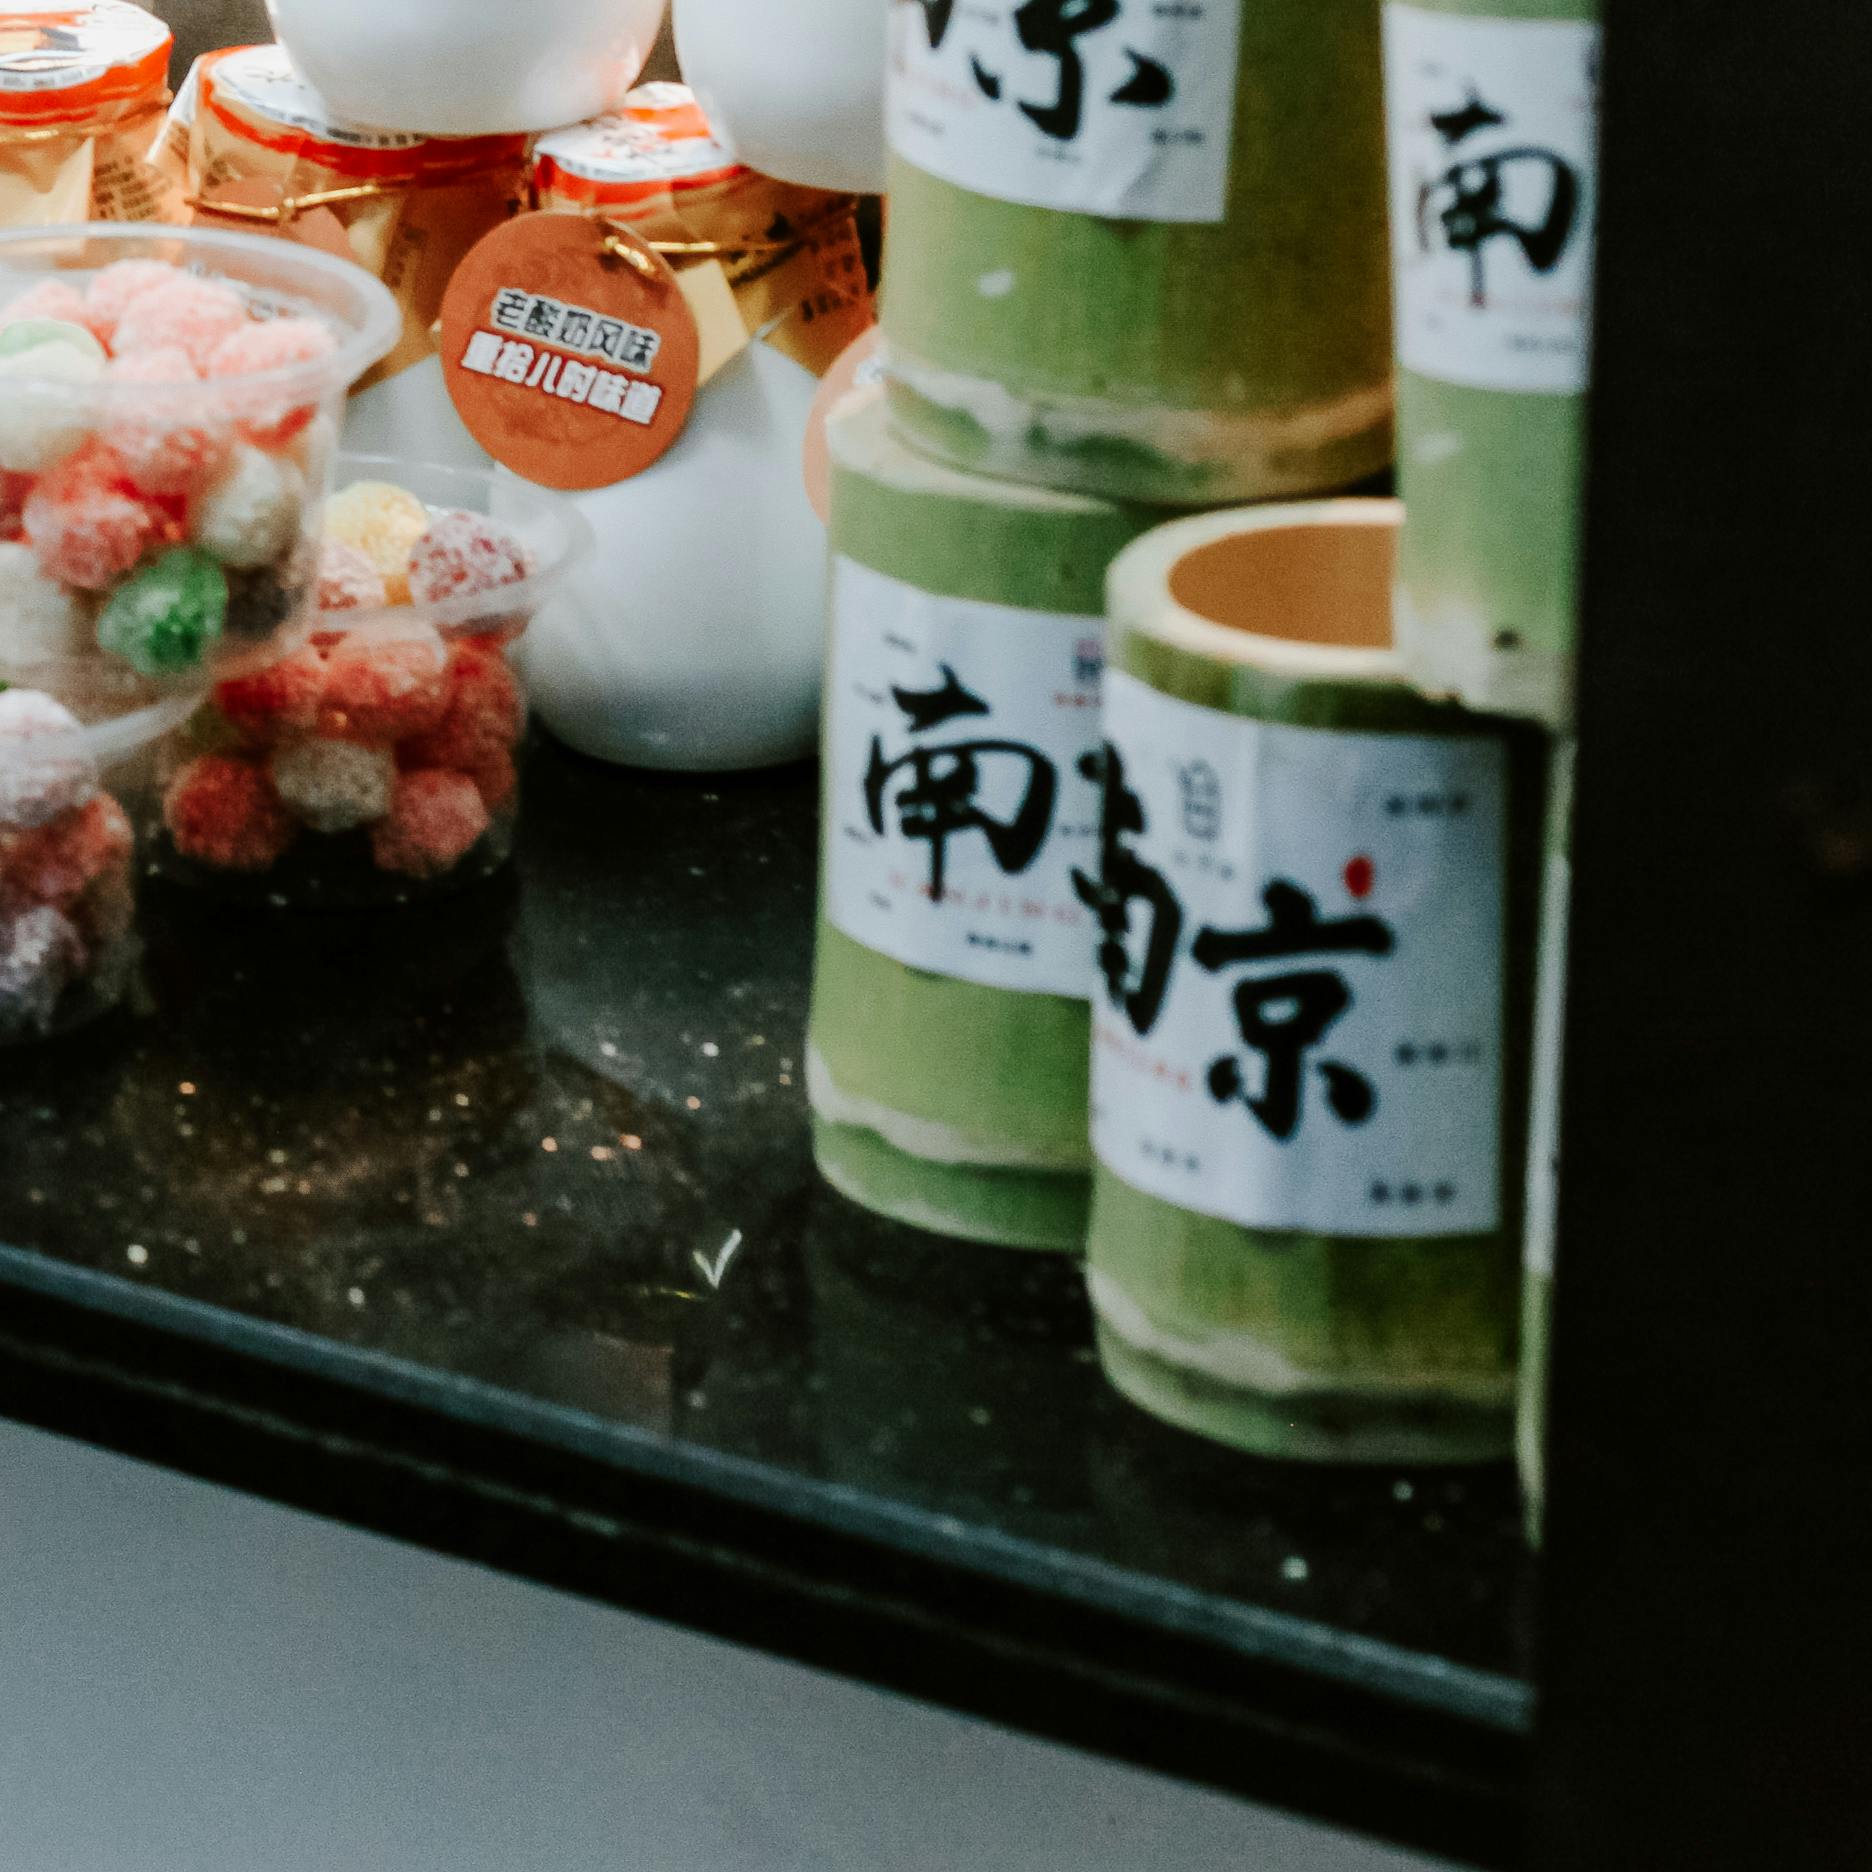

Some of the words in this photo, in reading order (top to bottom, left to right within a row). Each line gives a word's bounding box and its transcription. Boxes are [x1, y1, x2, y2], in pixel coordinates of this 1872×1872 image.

[1418, 76, 1578, 308] 南
[460, 330, 662, 425] 重拾儿时味道
[492, 288, 661, 374] 老酸奶风味
